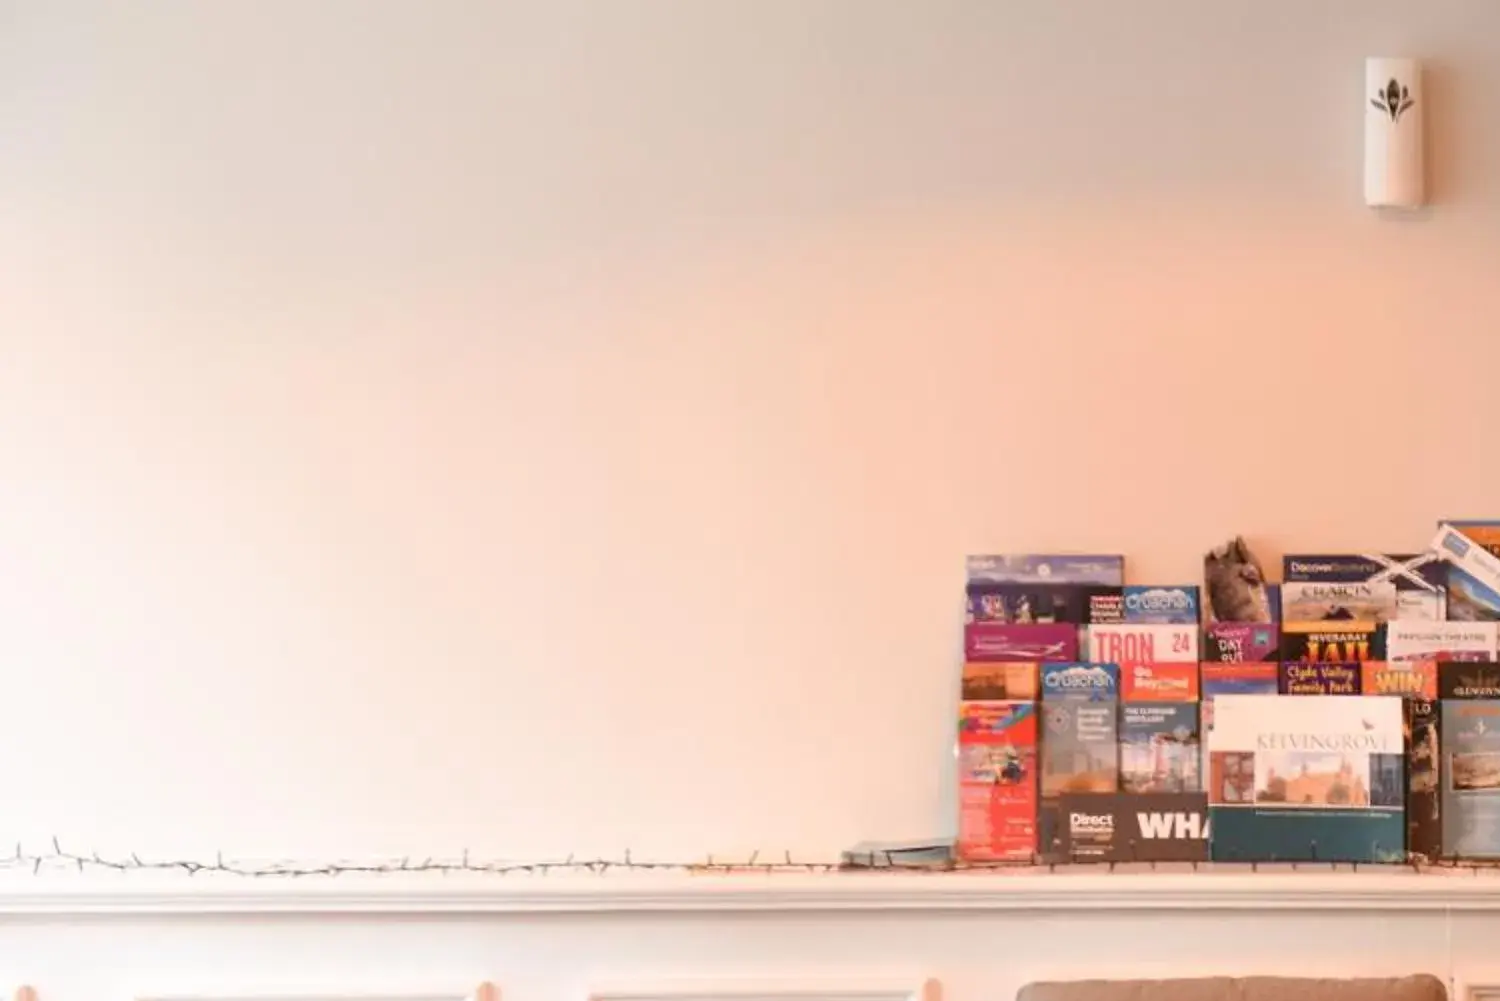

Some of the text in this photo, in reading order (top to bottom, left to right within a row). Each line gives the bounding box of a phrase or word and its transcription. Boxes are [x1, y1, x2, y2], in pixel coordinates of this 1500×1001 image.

[1094, 632, 1190, 663] TRON 24
[1287, 664, 1353, 681] Clyde Valley
[1376, 670, 1423, 693] WIN
[1069, 813, 1113, 827] Direct
